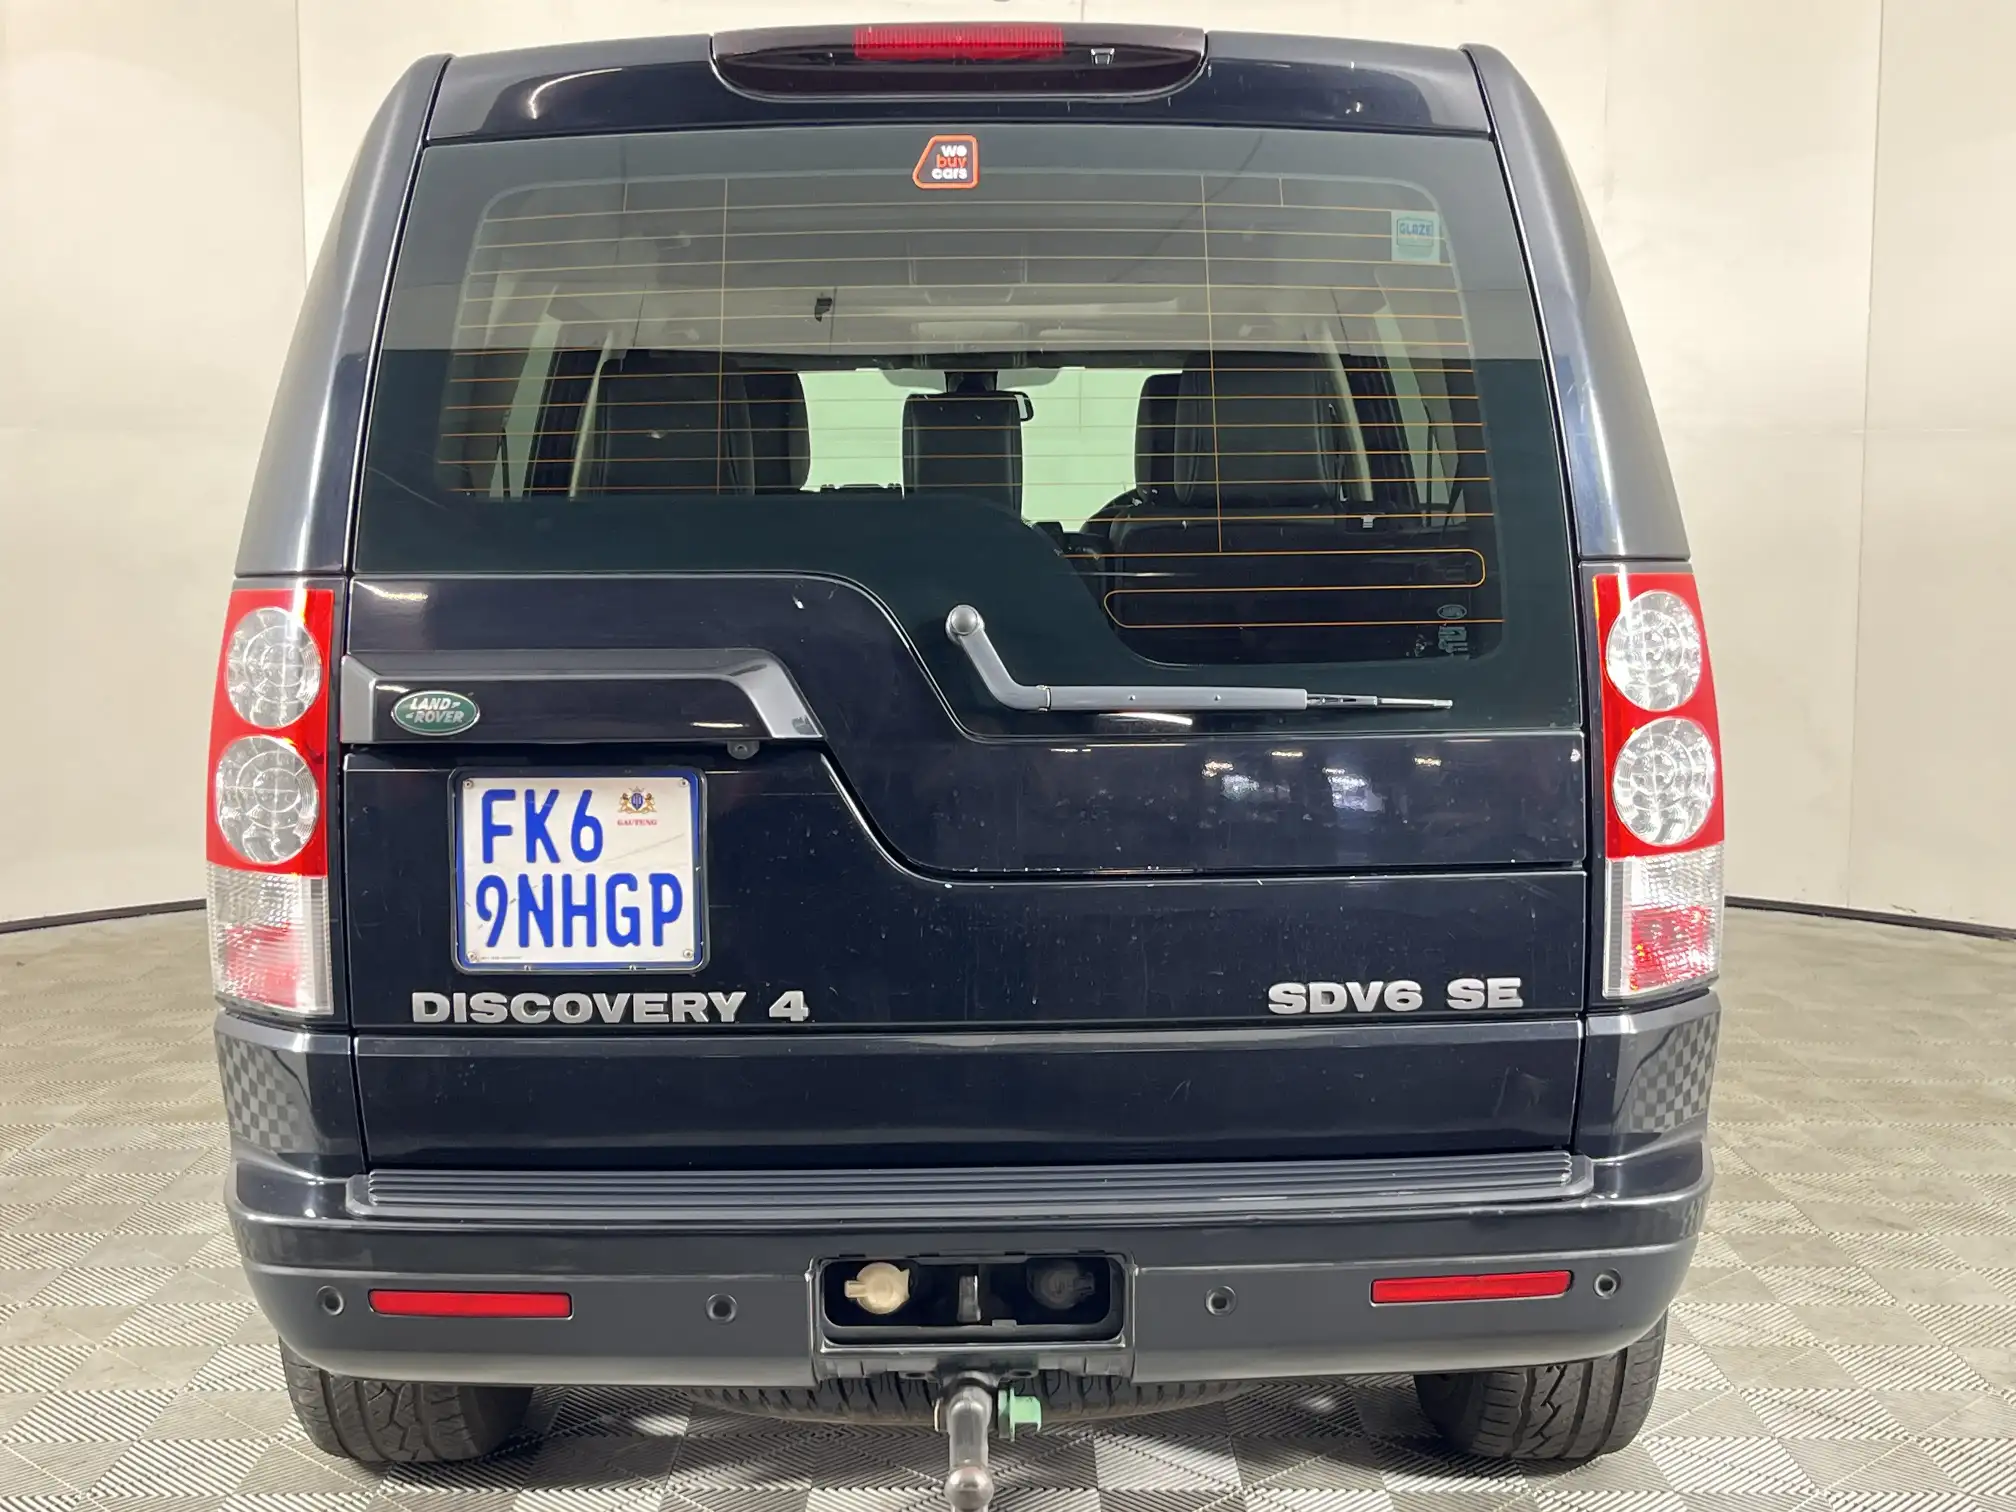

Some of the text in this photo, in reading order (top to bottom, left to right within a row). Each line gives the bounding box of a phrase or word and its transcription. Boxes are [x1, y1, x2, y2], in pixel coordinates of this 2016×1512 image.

[936, 154, 967, 168] buy
[931, 168, 968, 179] cars
[409, 697, 452, 710] LAND
[413, 710, 465, 723] ROVER
[481, 789, 604, 864] FK6
[617, 818, 658, 826] GAUTENG
[476, 873, 683, 948] 9NHGP
[1268, 977, 1524, 1015] SDV6 SE
[411, 990, 809, 1024] DISCOVERY 4
